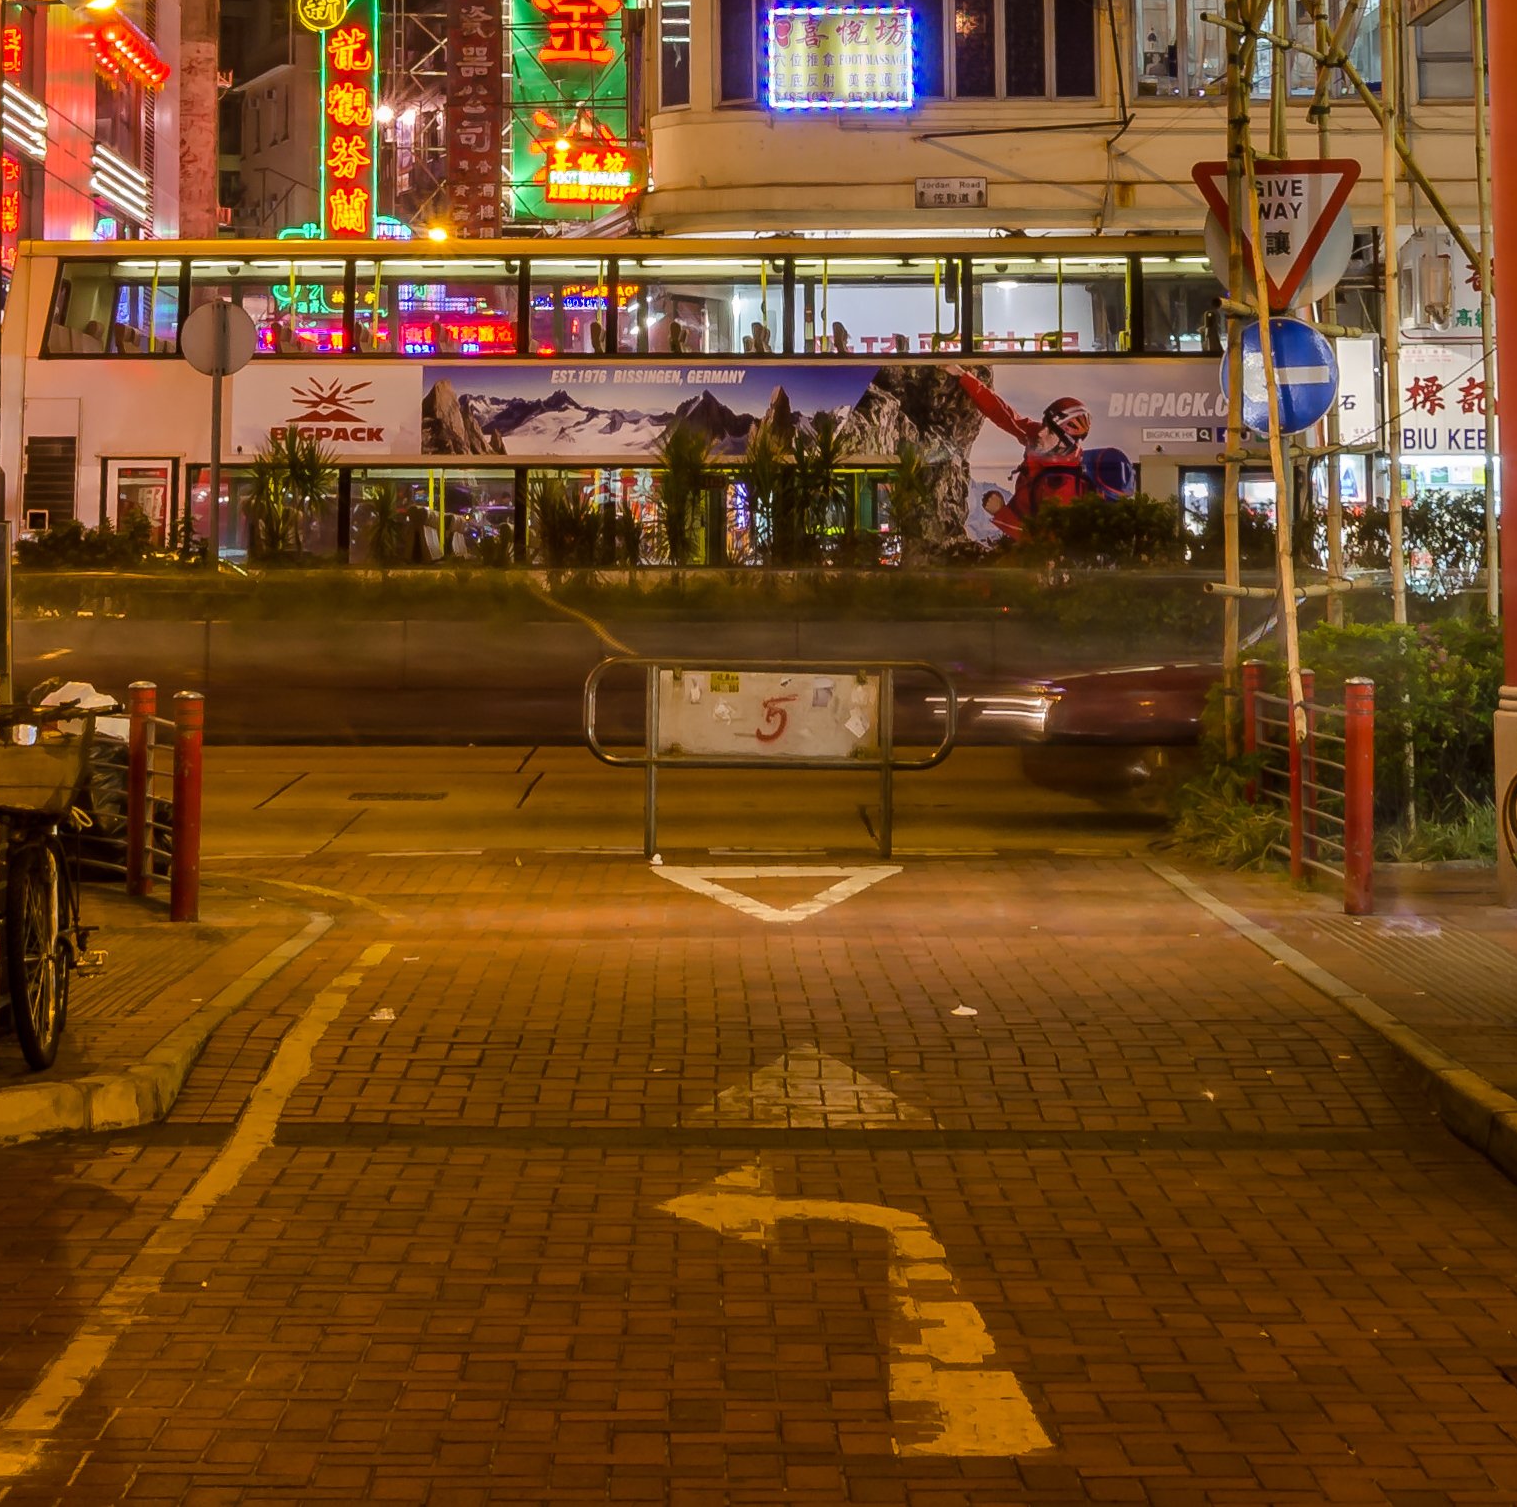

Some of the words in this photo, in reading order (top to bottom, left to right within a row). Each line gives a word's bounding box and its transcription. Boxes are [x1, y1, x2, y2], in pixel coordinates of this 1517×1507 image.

[959, 181, 981, 189] Road
[613, 369, 684, 387] BISSINGEN,
[687, 369, 746, 385] GERMANY
[1403, 428, 1438, 450] BIU
